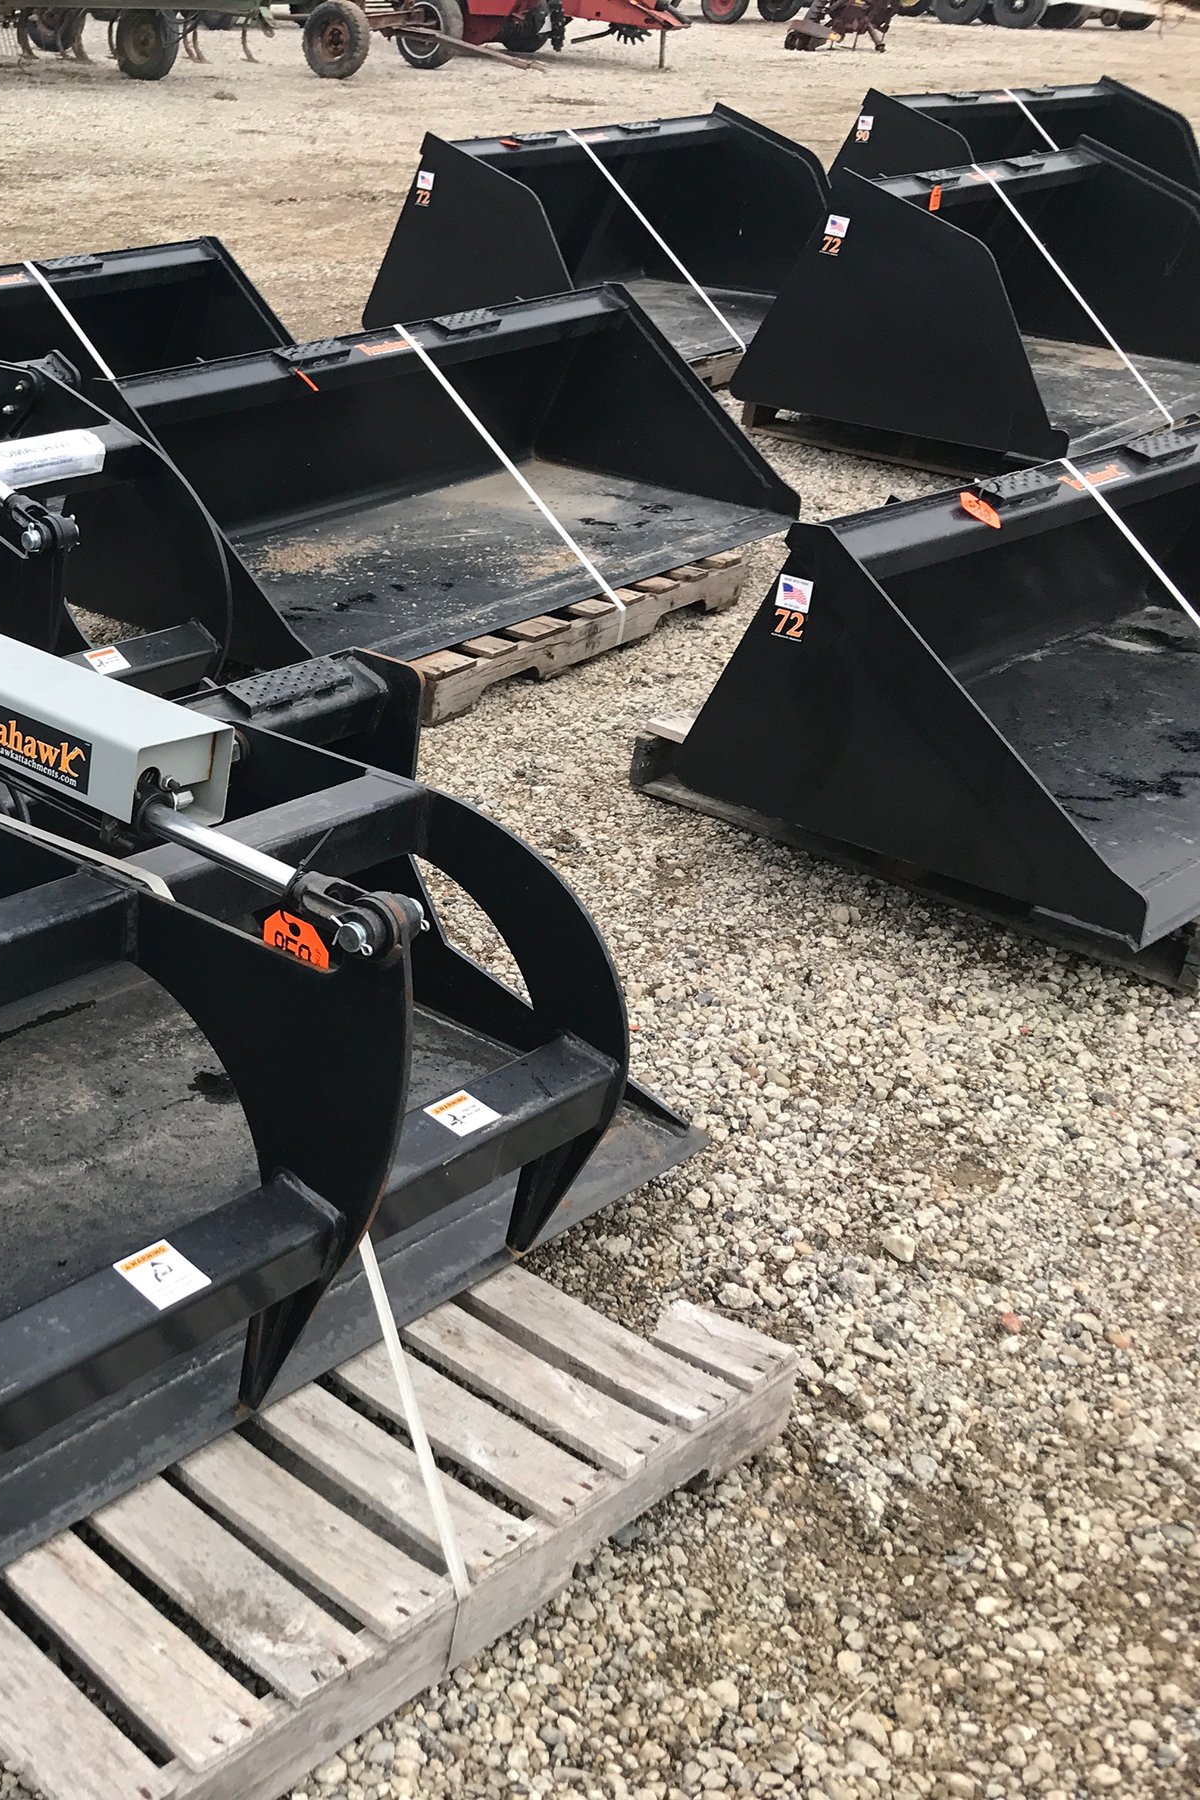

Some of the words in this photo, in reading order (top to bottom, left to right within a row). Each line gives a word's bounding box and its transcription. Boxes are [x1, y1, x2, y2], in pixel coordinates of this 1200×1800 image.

[855, 130, 870, 142] 90
[416, 189, 431, 205] 72
[821, 235, 842, 254] 72
[774, 607, 805, 638] 72
